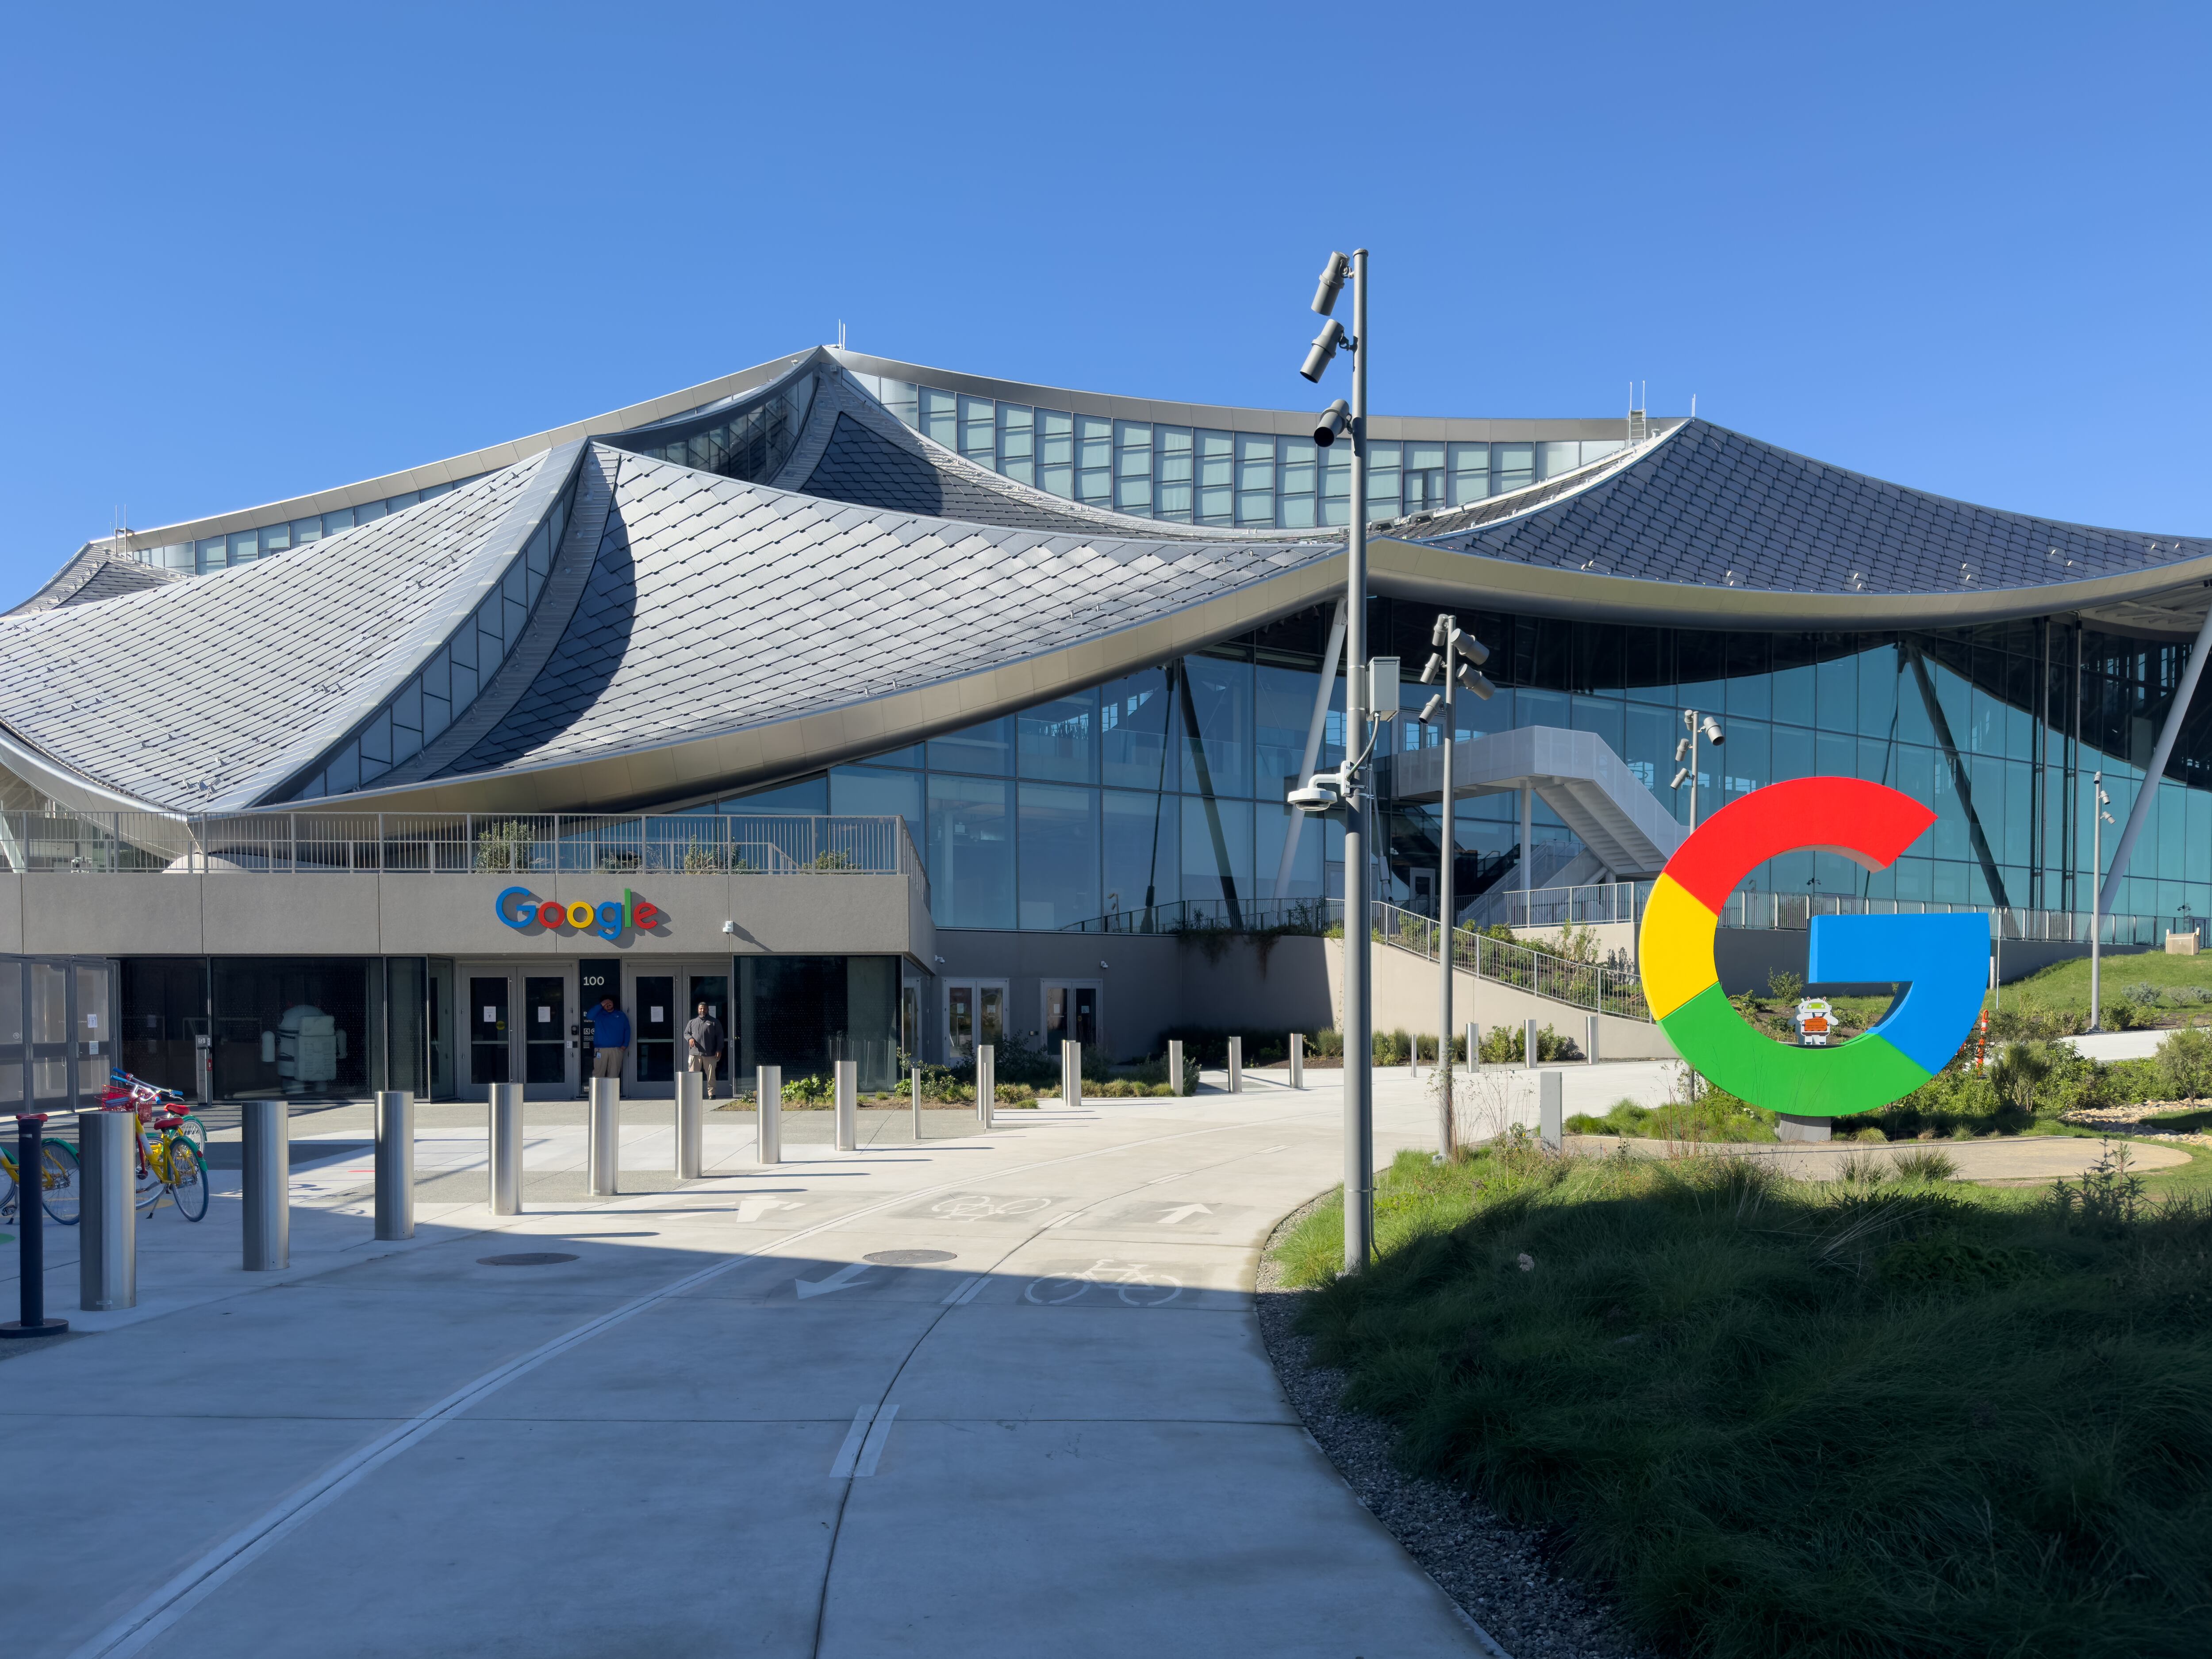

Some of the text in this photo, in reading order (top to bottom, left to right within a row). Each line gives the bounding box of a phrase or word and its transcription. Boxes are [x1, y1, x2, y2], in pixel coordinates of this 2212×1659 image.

[495, 886, 658, 941] Google
[1639, 776, 1991, 1117] G
[584, 976, 604, 986] 100
